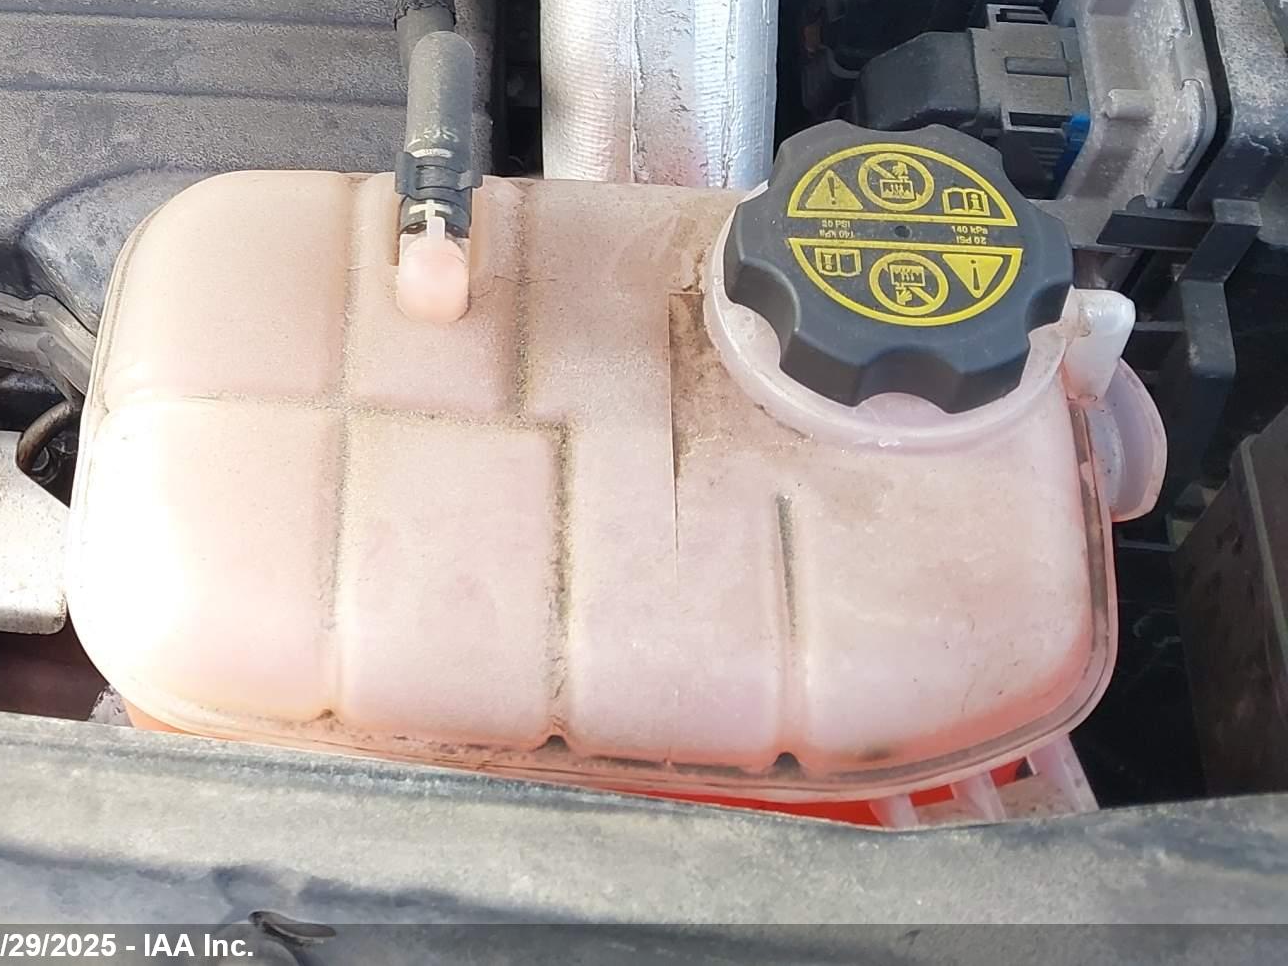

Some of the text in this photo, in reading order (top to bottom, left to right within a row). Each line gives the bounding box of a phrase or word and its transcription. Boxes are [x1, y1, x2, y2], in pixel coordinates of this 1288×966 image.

[821, 219, 851, 228] 20 PSI
[951, 225, 989, 235] 140 kPa
[955, 235, 987, 245] 20 PSI
